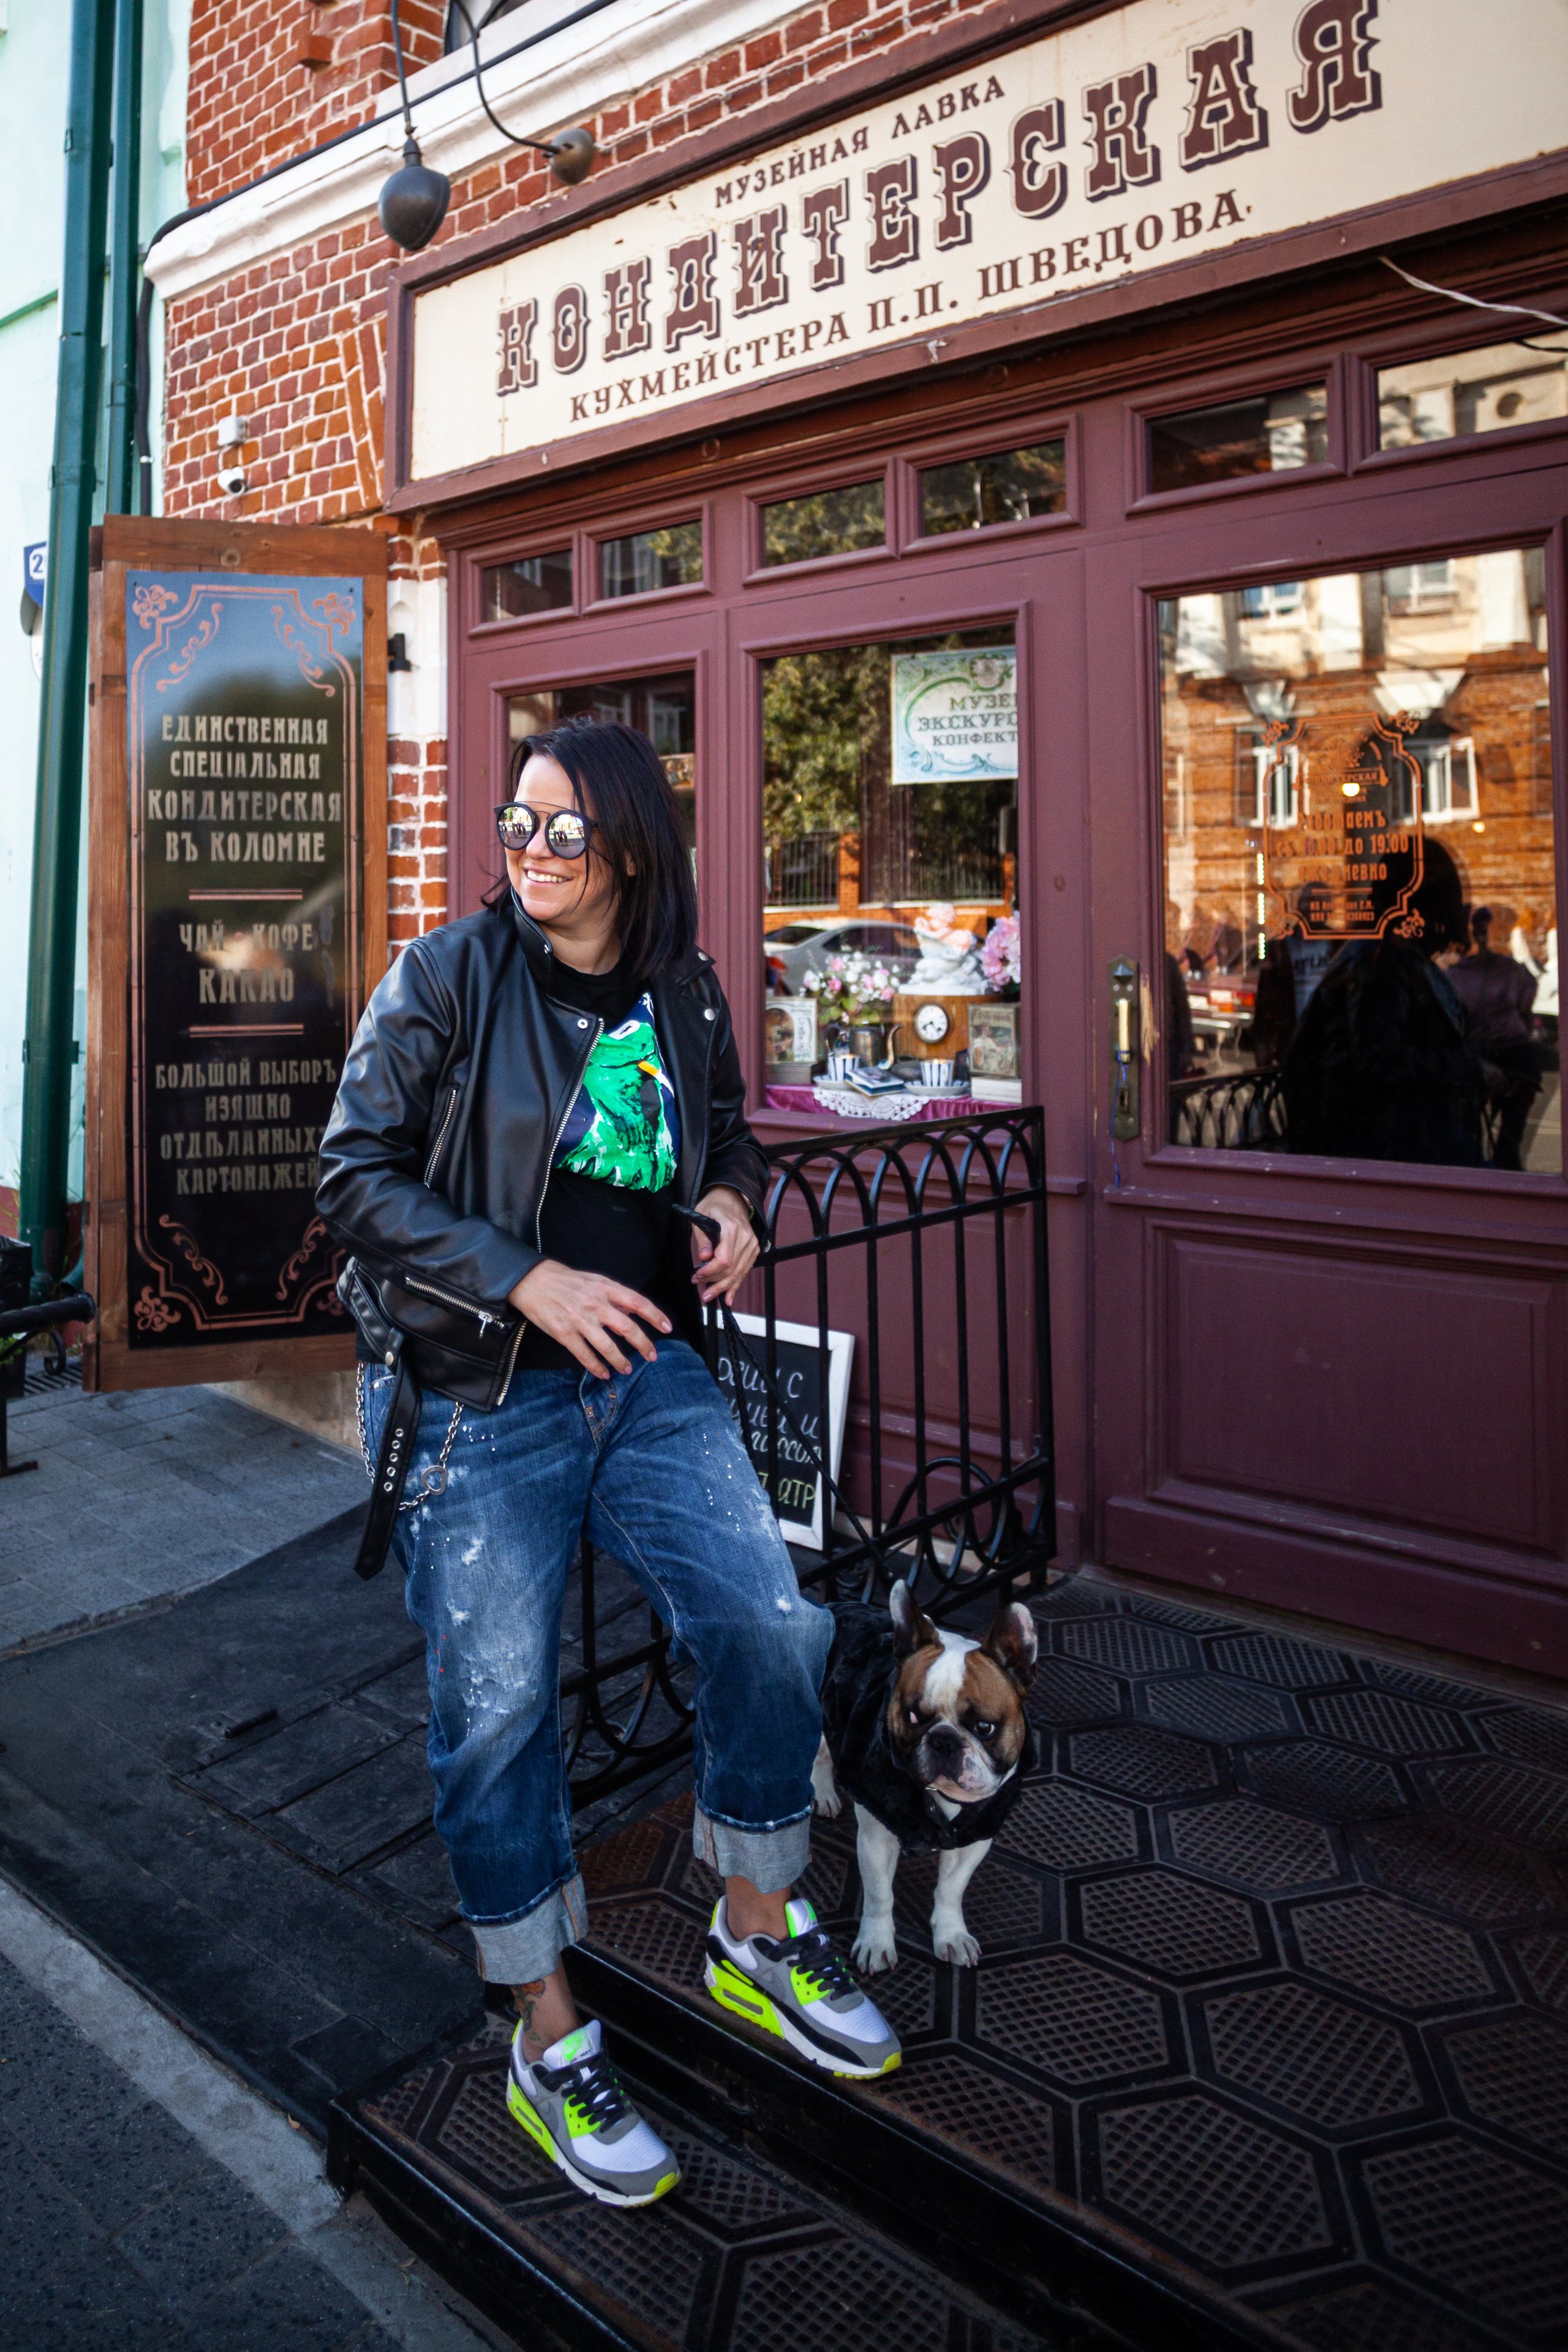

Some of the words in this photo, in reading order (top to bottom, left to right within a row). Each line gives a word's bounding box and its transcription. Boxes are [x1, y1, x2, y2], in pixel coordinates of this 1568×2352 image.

[715, 126, 870, 208] МУЗЕЙНАЯ
[891, 75, 1005, 138] ЛАВКА
[496, 0, 1383, 396] КОНДИТЕРСКАЯ
[570, 313, 850, 423] КУХМЕЙСТЕРА
[867, 281, 958, 333] П.П.
[162, 714, 328, 745] ЕДИНСТВЕННАЯ
[148, 789, 342, 822] КОНДИТЕРСКАЯ
[165, 831, 199, 862] ВЪ
[211, 831, 326, 862] КОЛОМНЕ
[1345, 837, 1363, 856] до
[1370, 833, 1409, 854] 19:00
[179, 918, 225, 952] ЧАЙ
[252, 922, 314, 951] КОФЕ
[198, 967, 295, 1005] КАКАО
[155, 1057, 251, 1089] БОЛЬШОЙ
[258, 1059, 336, 1086] ВЫБОРЪ
[205, 1093, 291, 1122] ИЗЯЩНО
[160, 1126, 325, 1160] ОТДѢЛАННЫХ
[176, 1156, 318, 1194] КАРТОНАЖЕЙ
